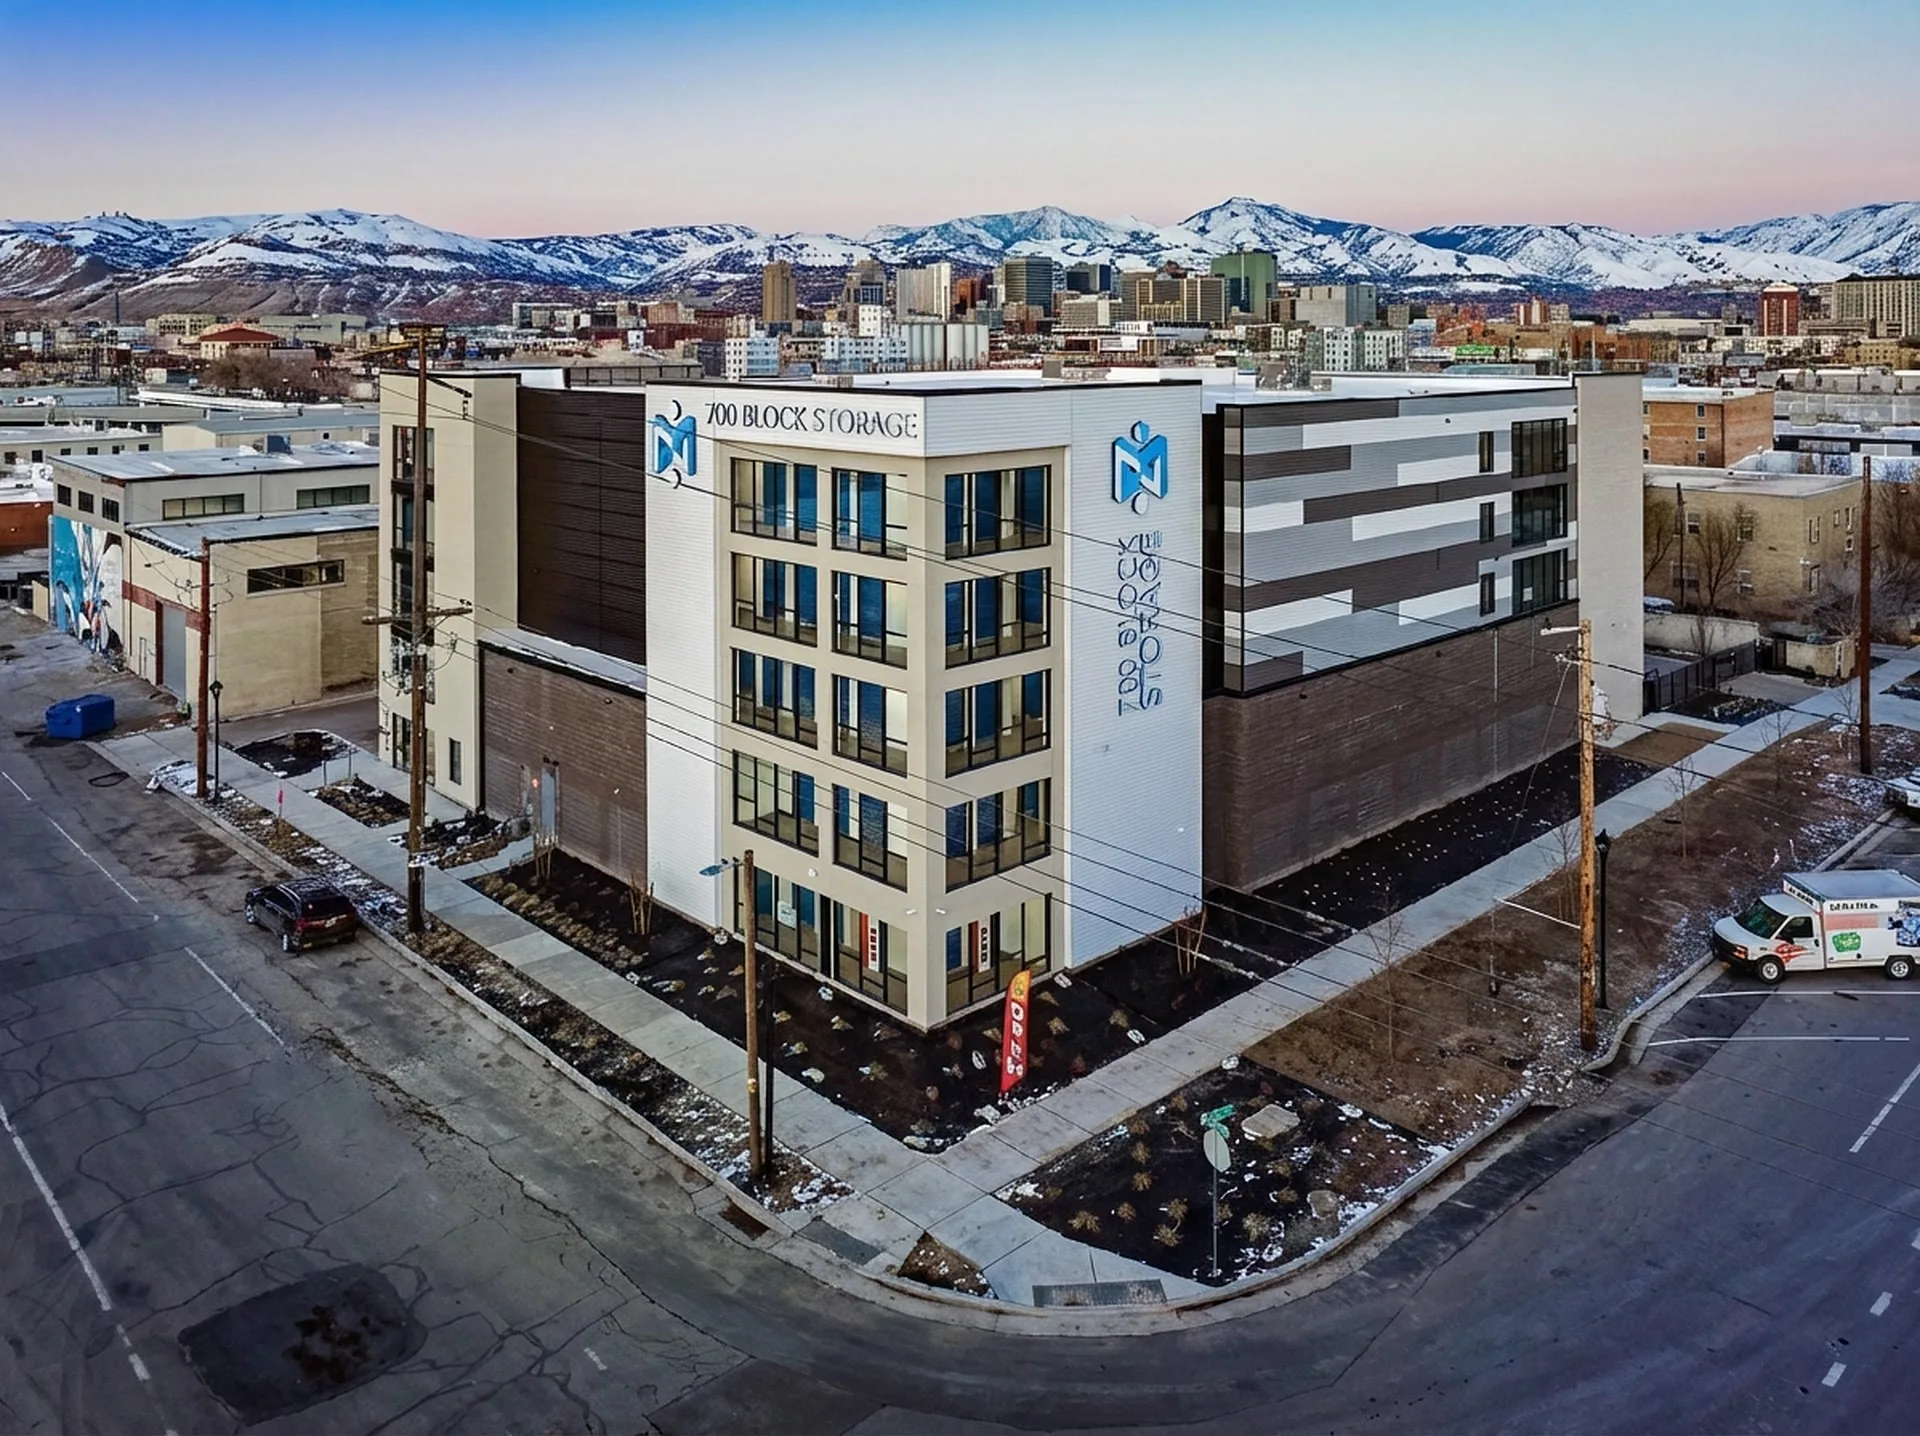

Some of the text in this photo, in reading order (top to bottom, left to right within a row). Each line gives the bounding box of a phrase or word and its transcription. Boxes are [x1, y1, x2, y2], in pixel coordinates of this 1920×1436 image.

[705, 402, 918, 438] 700 BLOCK STORAGE
